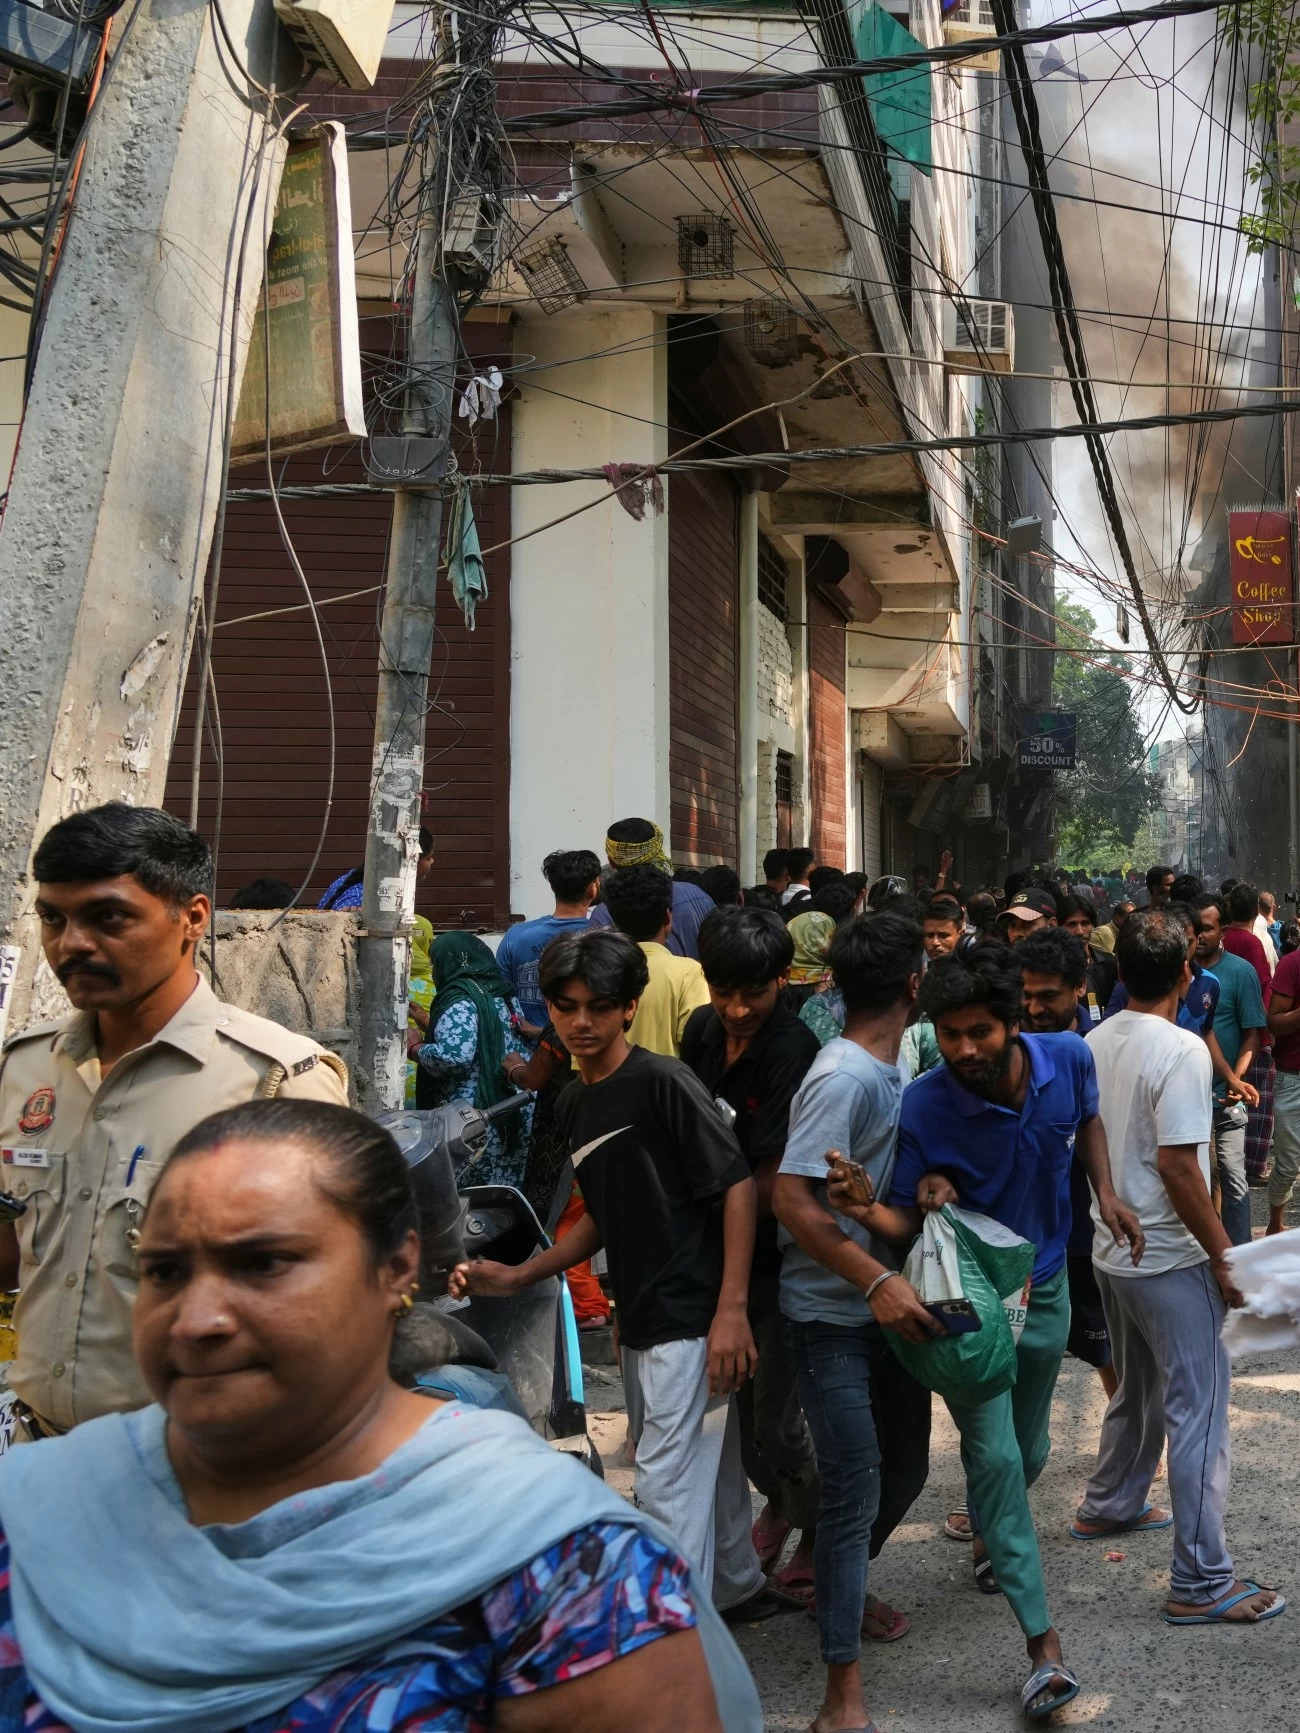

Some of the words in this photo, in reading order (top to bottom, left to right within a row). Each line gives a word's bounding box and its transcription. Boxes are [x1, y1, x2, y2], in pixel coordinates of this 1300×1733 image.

[1236, 580, 1287, 602] Coffee
[1243, 607, 1281, 627] Shop
[1021, 755, 1072, 767] DISCOUNT
